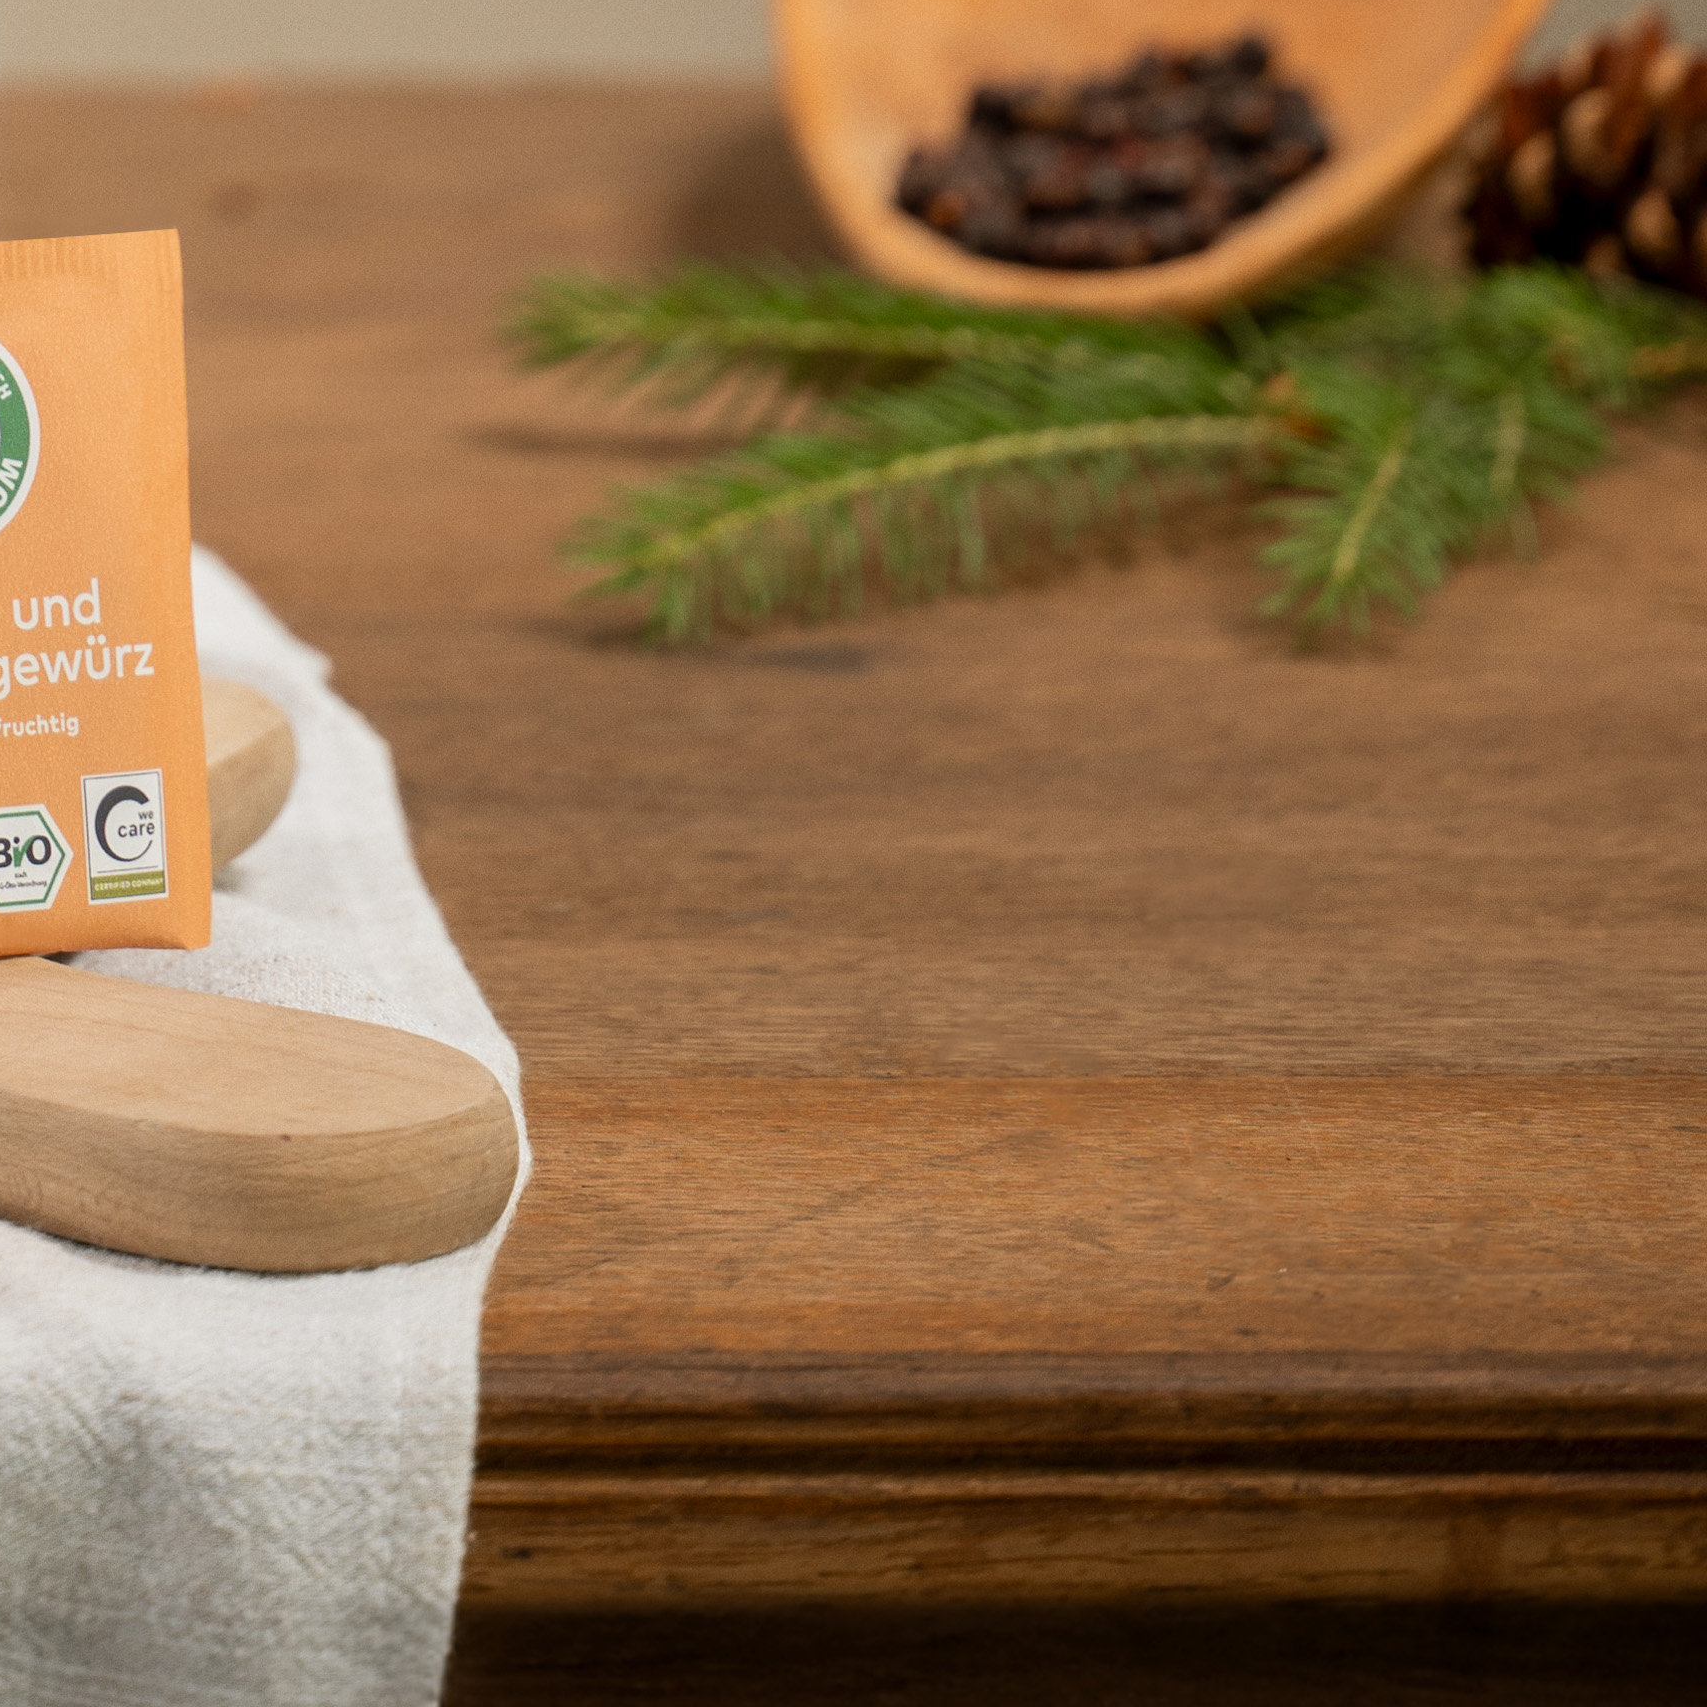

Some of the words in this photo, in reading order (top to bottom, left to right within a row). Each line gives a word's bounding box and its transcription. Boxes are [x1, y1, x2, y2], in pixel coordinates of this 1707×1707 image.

[12, 577, 102, 630] und
[138, 810, 154, 820] we
[117, 822, 156, 838] care
